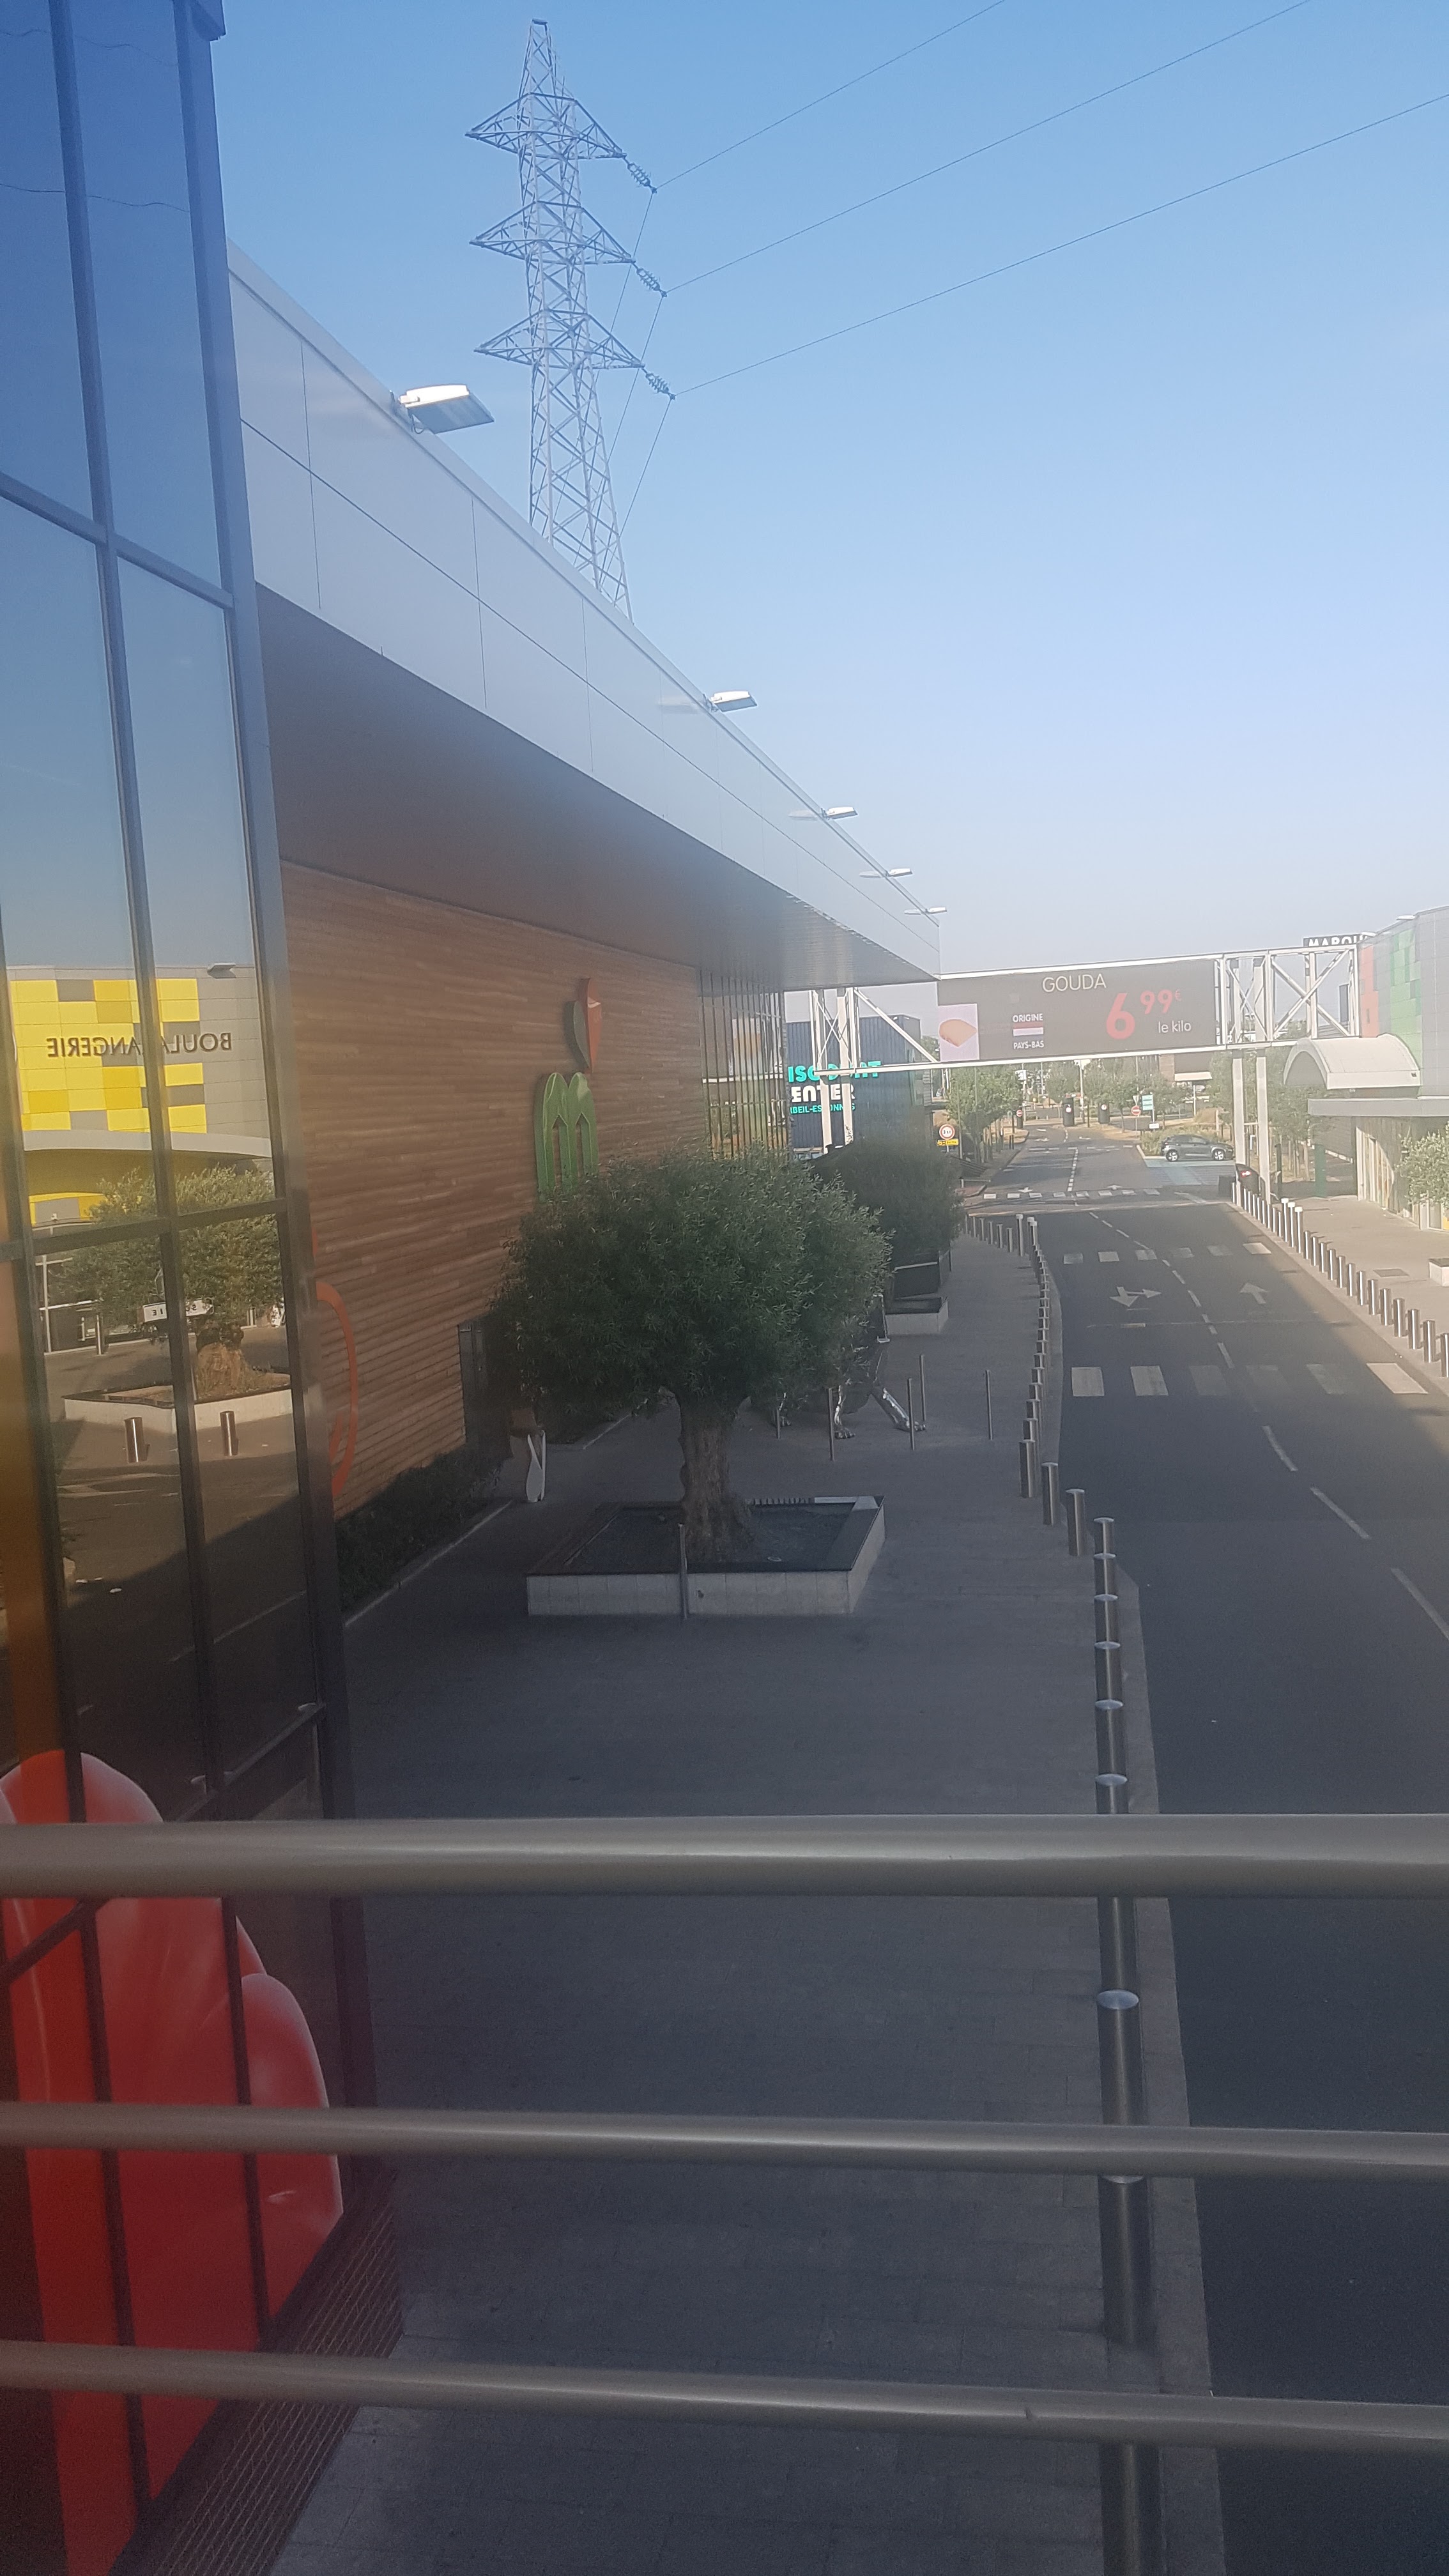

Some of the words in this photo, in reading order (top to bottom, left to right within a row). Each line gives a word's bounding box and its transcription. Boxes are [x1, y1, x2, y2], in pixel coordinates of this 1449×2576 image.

[1042, 973, 1107, 992] GOUDA
[1012, 1013, 1044, 1023] ORIGINE
[1158, 1021, 1169, 1034] le
[1171, 1020, 1192, 1033] kilo
[1013, 1040, 1045, 1050] PAYS-BAS
